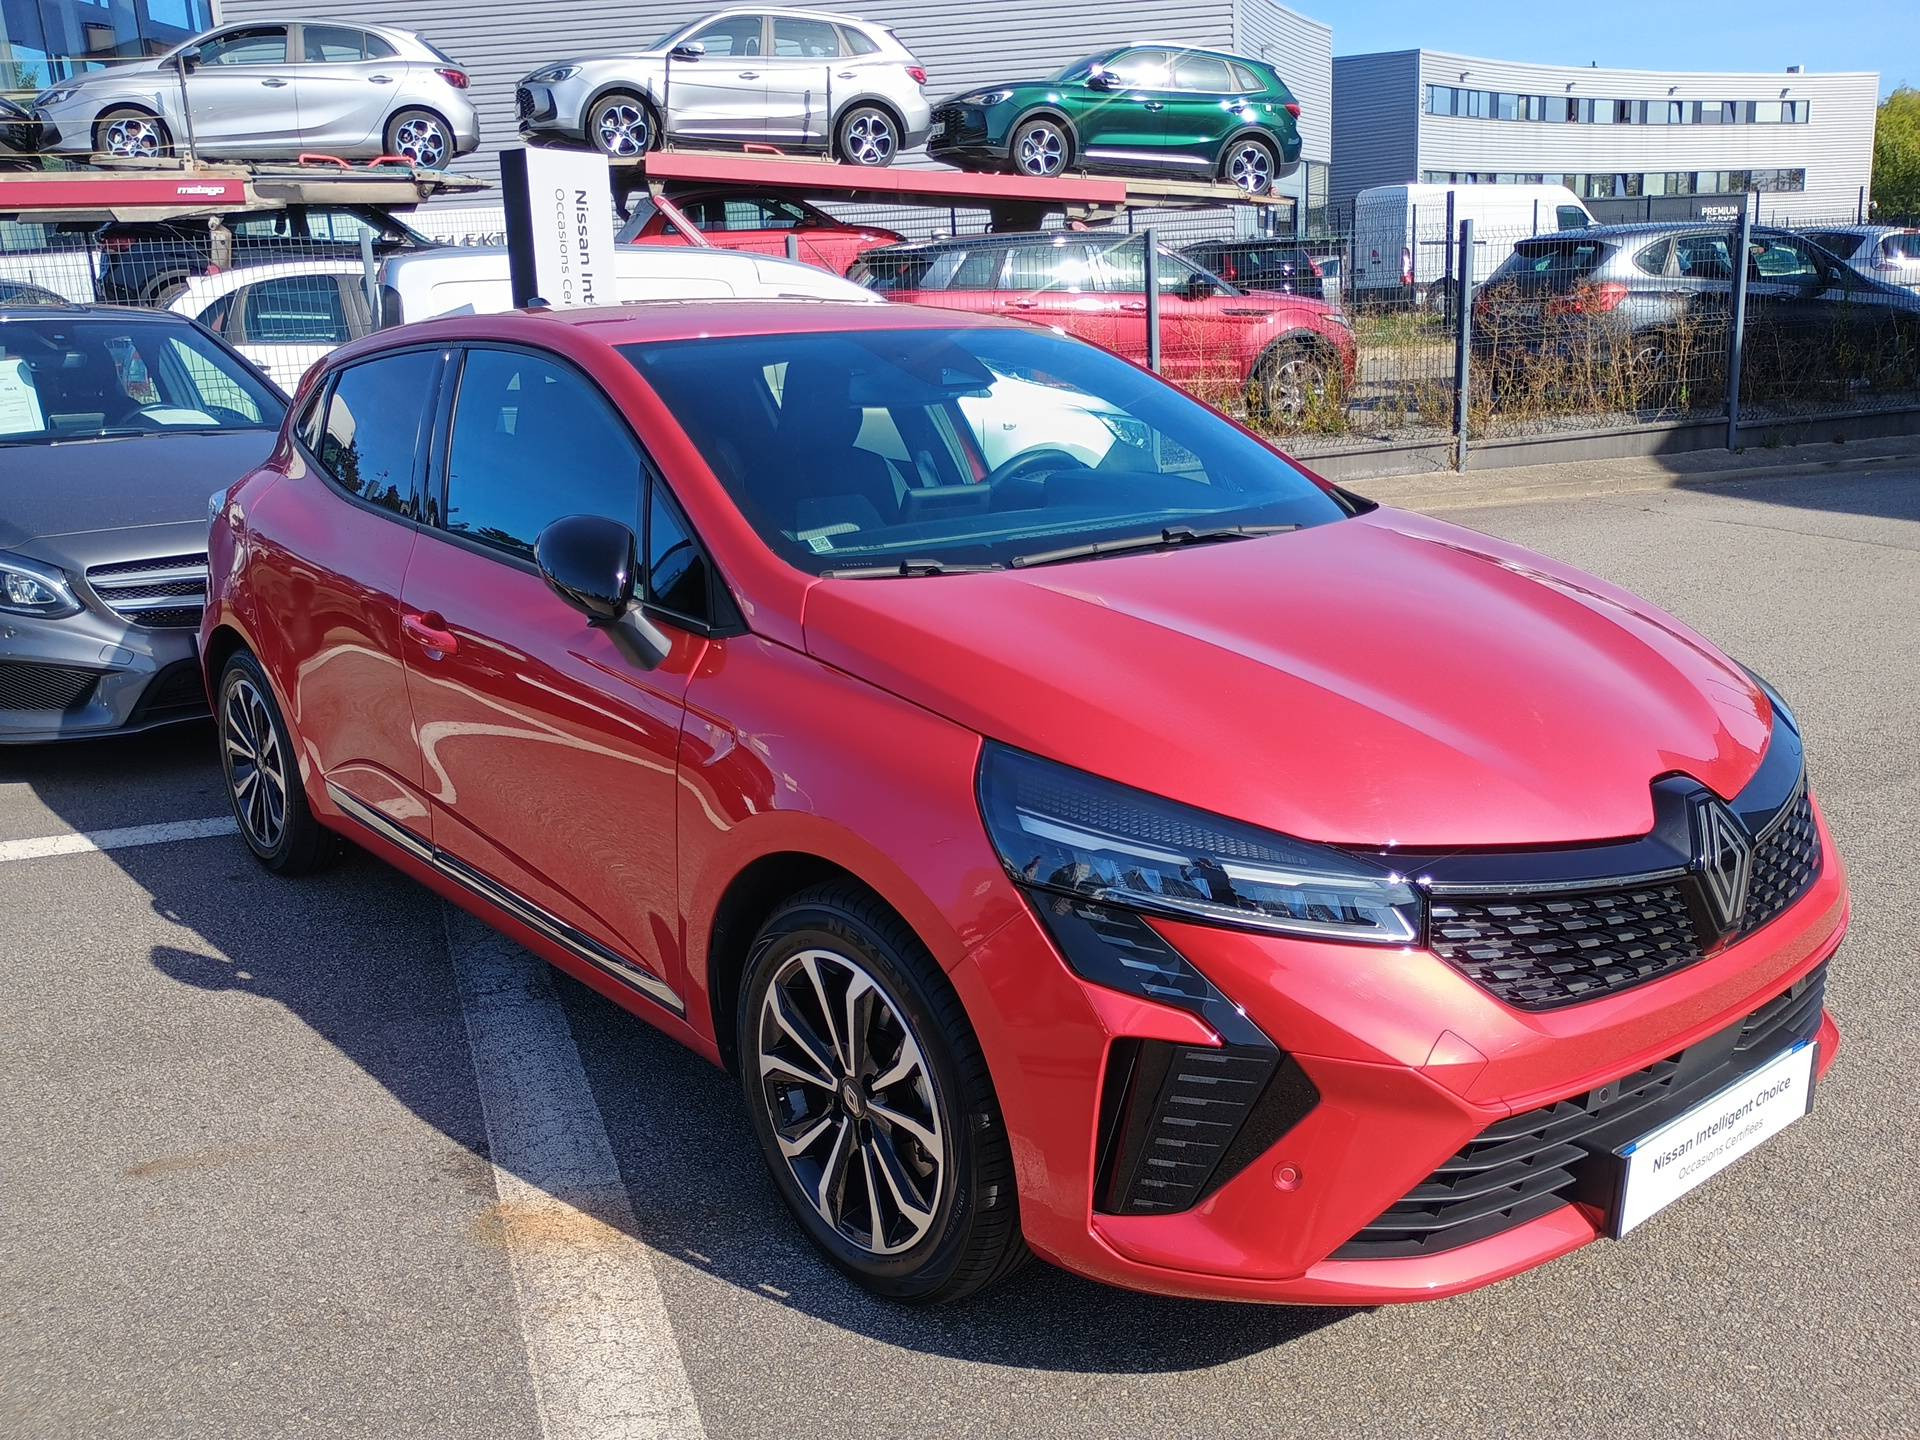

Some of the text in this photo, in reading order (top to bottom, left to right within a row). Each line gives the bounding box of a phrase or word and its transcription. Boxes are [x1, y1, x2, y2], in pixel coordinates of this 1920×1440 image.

[555, 188, 570, 274] Occasions
[574, 189, 591, 265] Nissan
[1701, 206, 1738, 216] PREMIUM
[827, 919, 911, 996] NEXEN
[1653, 1077, 1791, 1173] Nissan Intelligent Choice
[1678, 1144, 1724, 1180] Occasions
